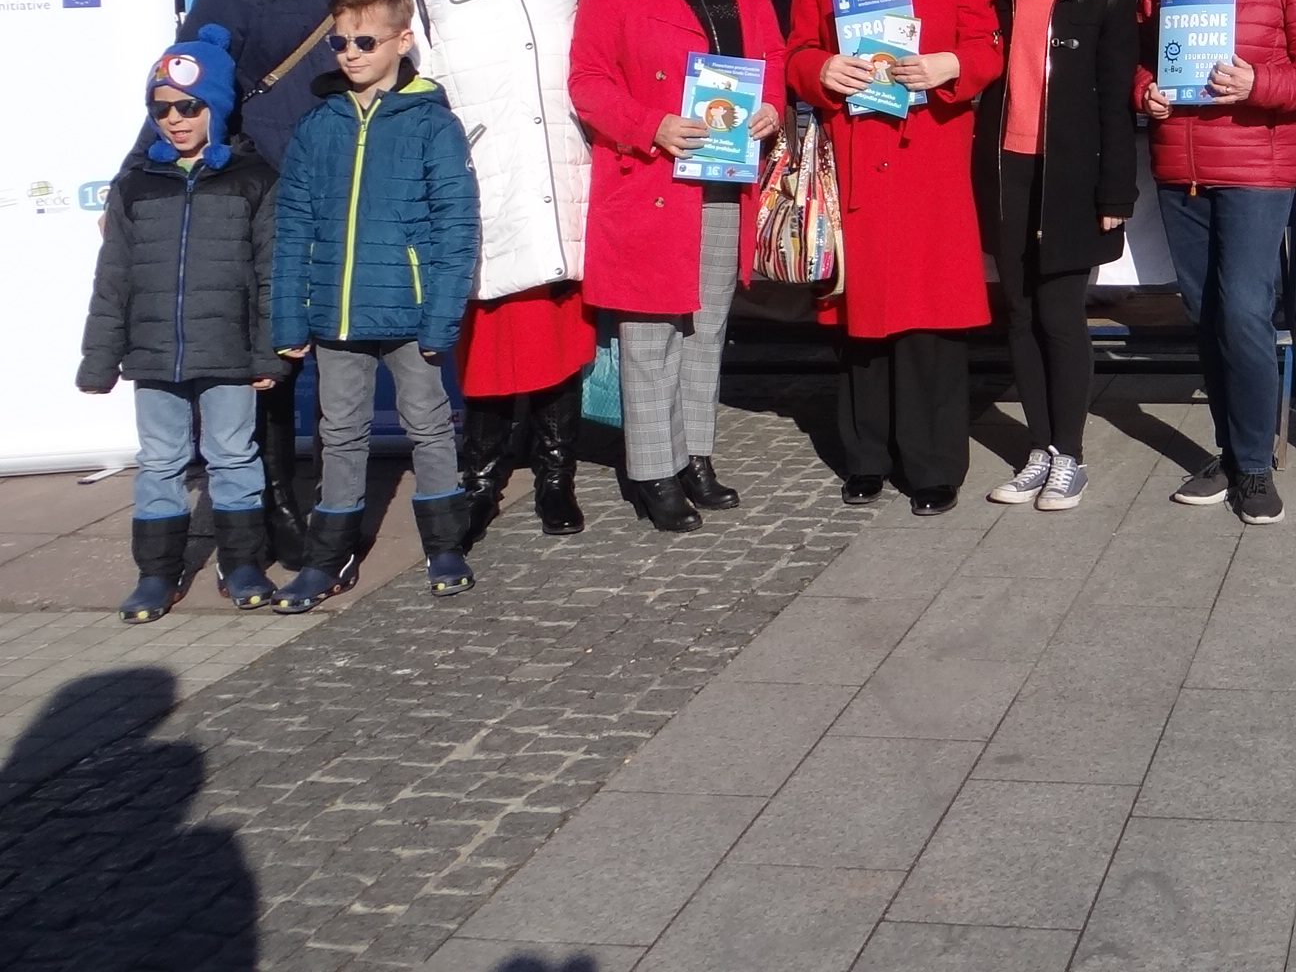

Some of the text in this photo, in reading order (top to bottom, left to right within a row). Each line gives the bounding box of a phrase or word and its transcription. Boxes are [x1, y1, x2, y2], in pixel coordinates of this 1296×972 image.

[843, 19, 886, 39] STRA
[1164, 10, 1228, 30] STRAŠNE
[1188, 32, 1228, 47] RUKE
